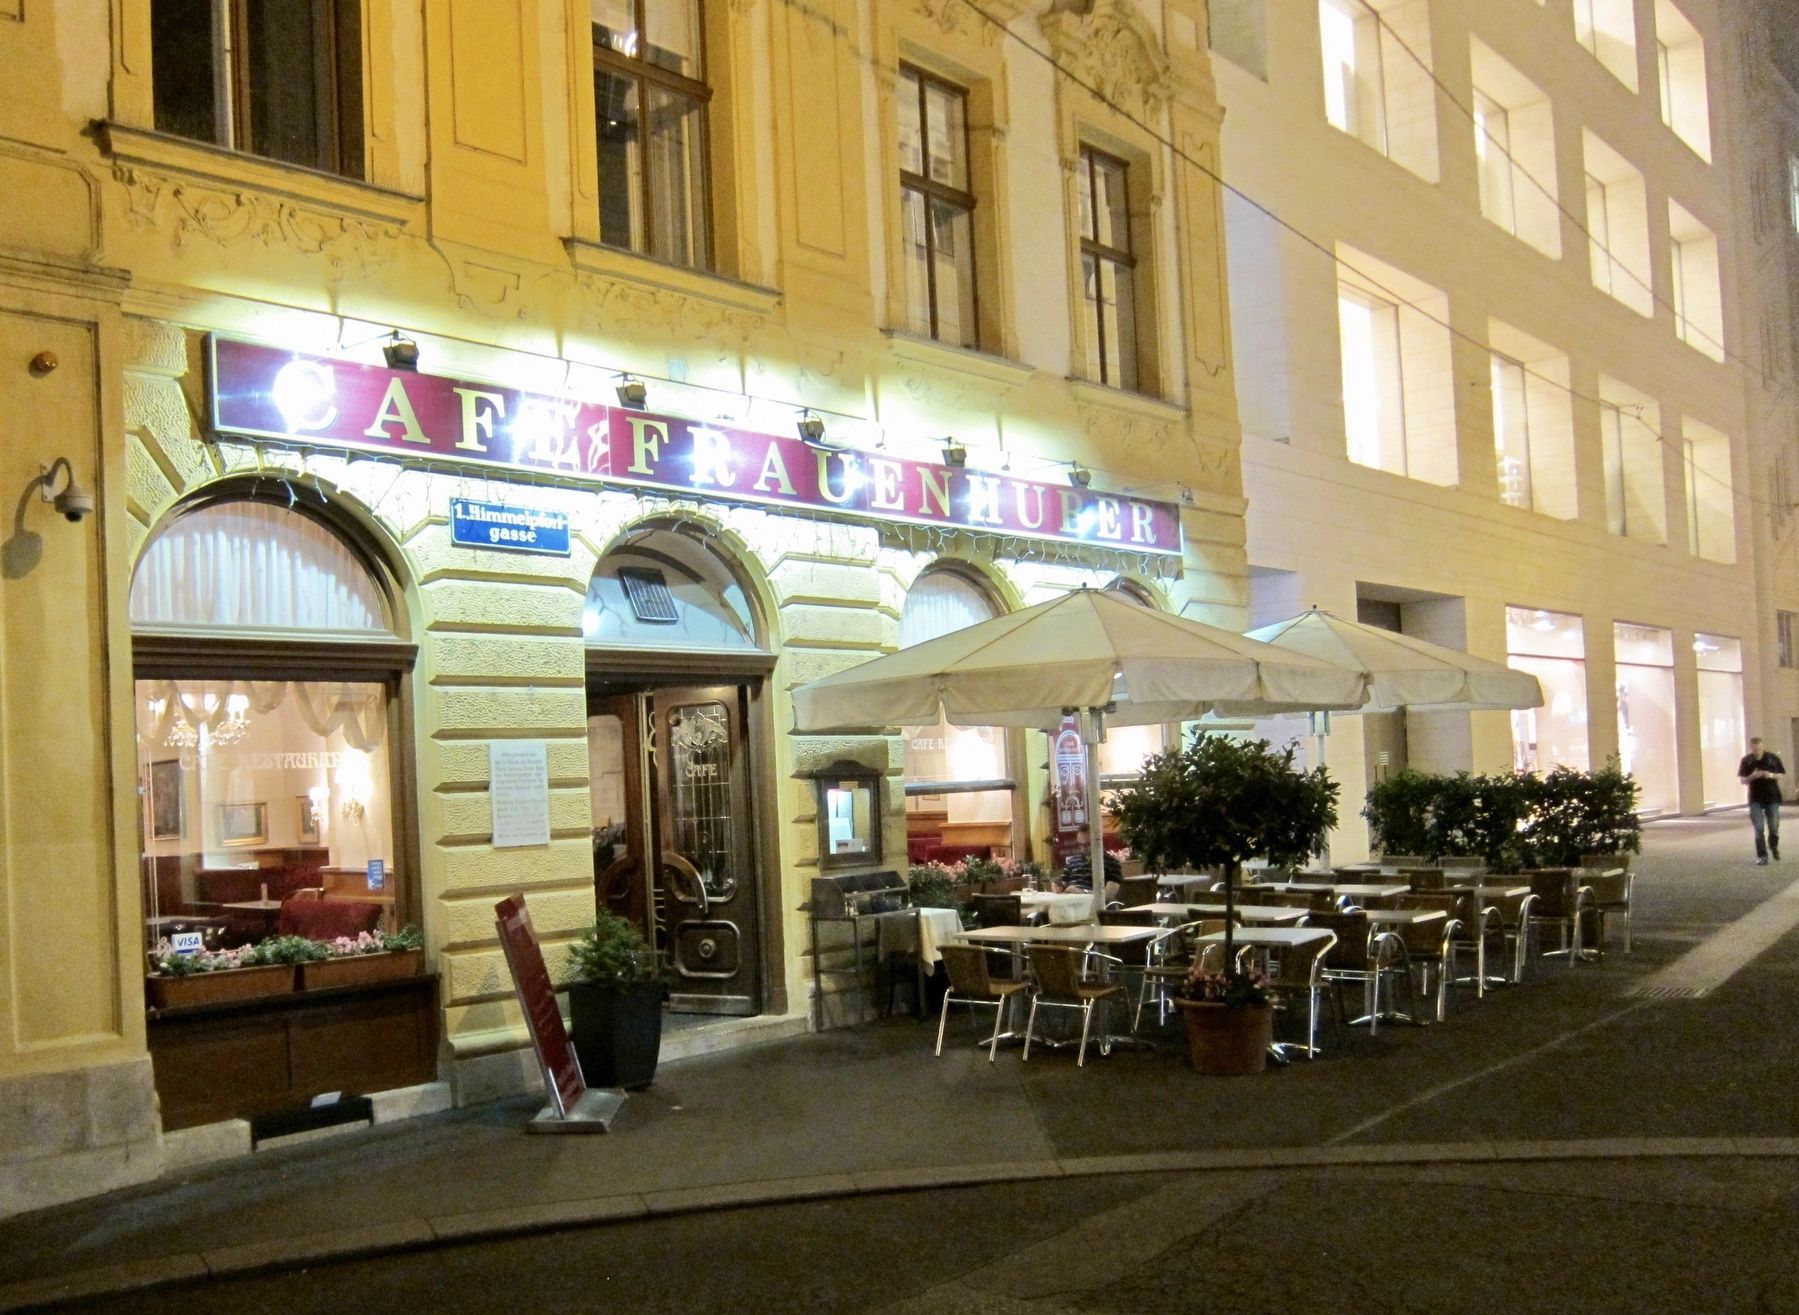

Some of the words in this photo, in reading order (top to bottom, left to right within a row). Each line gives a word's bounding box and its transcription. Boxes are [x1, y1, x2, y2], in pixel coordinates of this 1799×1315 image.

[626, 416, 1158, 544] FRAUENHUBER
[489, 527, 537, 544] gasse
[239, 752, 344, 769] RESTAURAN
[177, 936, 200, 947] VISA
